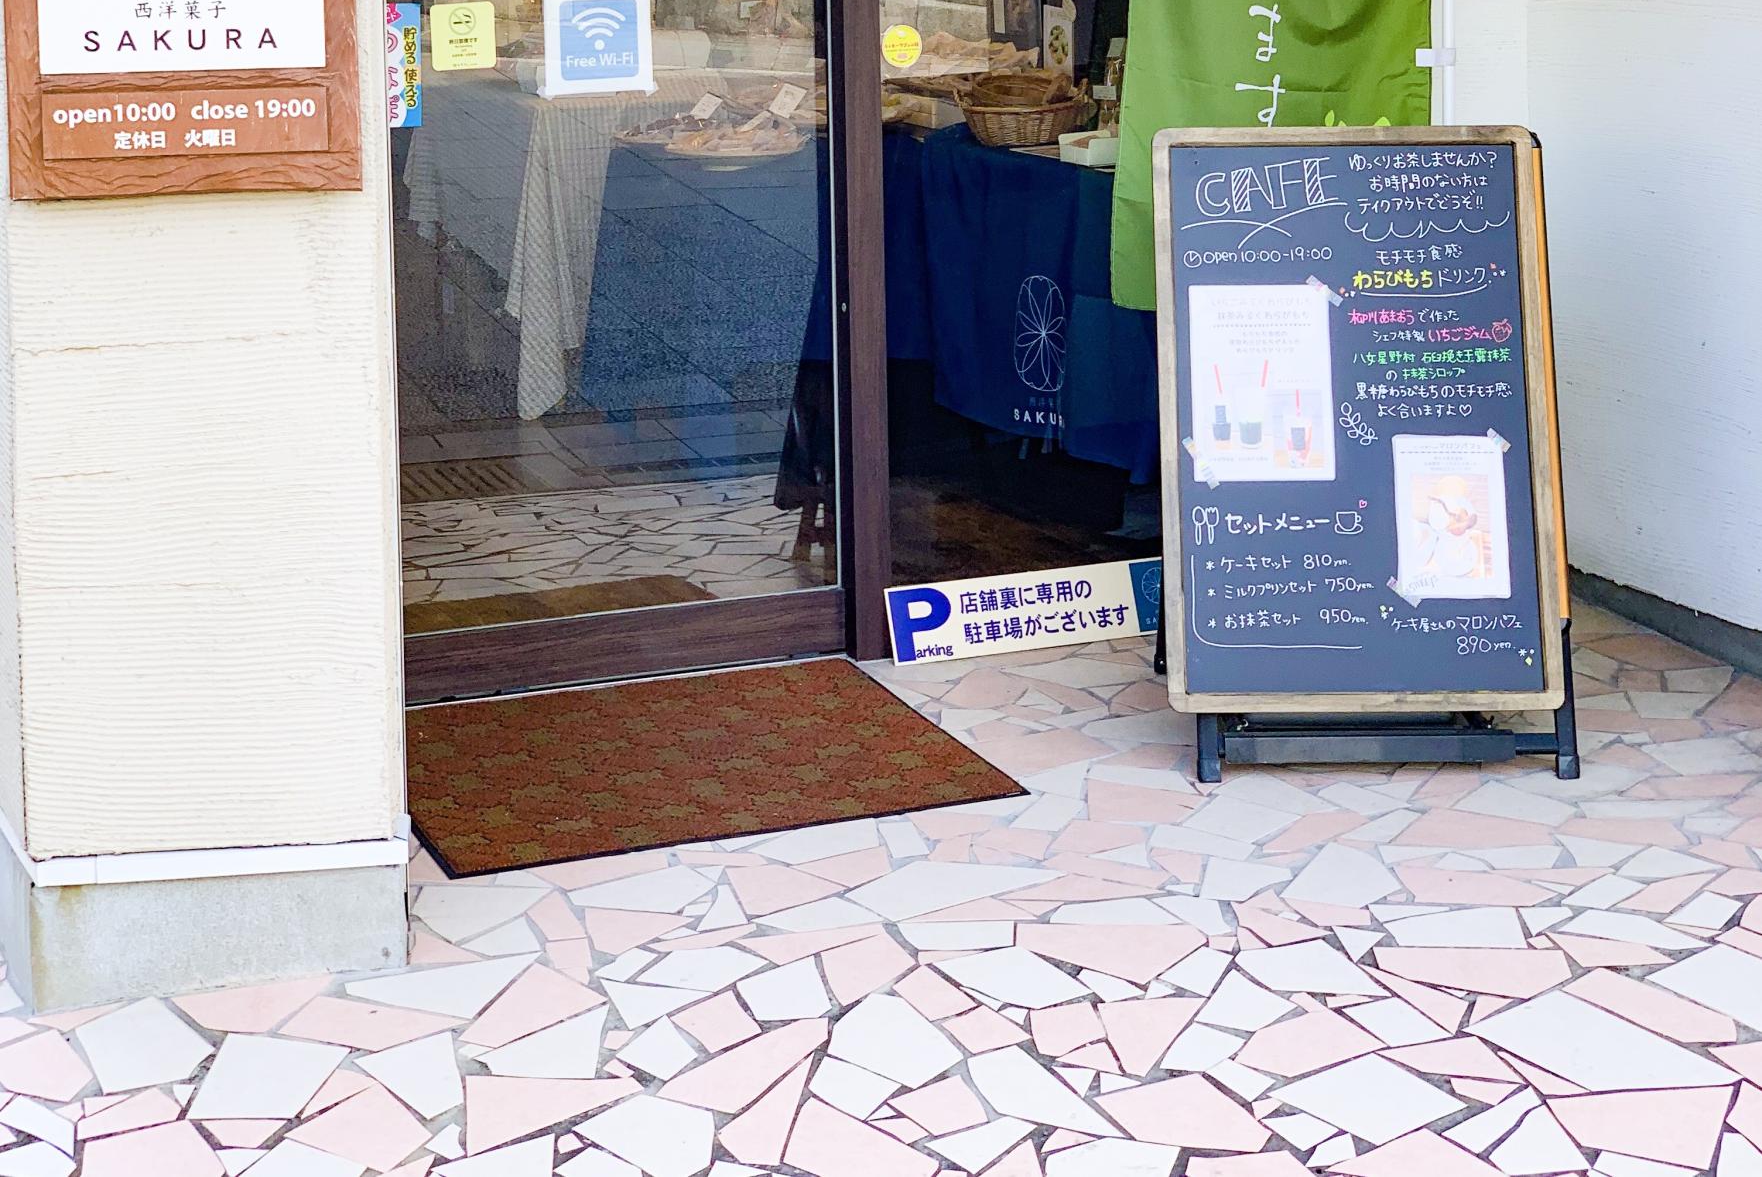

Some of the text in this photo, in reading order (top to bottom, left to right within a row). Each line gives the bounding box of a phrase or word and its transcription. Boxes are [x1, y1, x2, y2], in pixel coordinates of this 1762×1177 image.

[134, 0, 227, 20] 西洋菓子
[84, 27, 278, 52] SAKURA
[566, 52, 634, 69] Free Wi-Fi
[191, 99, 249, 120] close
[254, 98, 316, 119] 19:00
[114, 128, 237, 150] 定休日 火曜日
[1196, 157, 1339, 217] CAFE
[1368, 173, 1489, 193] お時間のない方は
[1375, 243, 1463, 266] モチモチ食感
[1224, 512, 1331, 535] セットメニュー
[1220, 553, 1292, 574] ケーキセット
[960, 578, 1093, 615] 店舗裏に専用の
[1223, 580, 1317, 600] ミルクプリンセット
[963, 603, 1131, 646] 駐車場がございます
[1224, 609, 1301, 629] お抹茶セット
[1391, 613, 1523, 633] ケーキ屋さんのマロンパフェ
